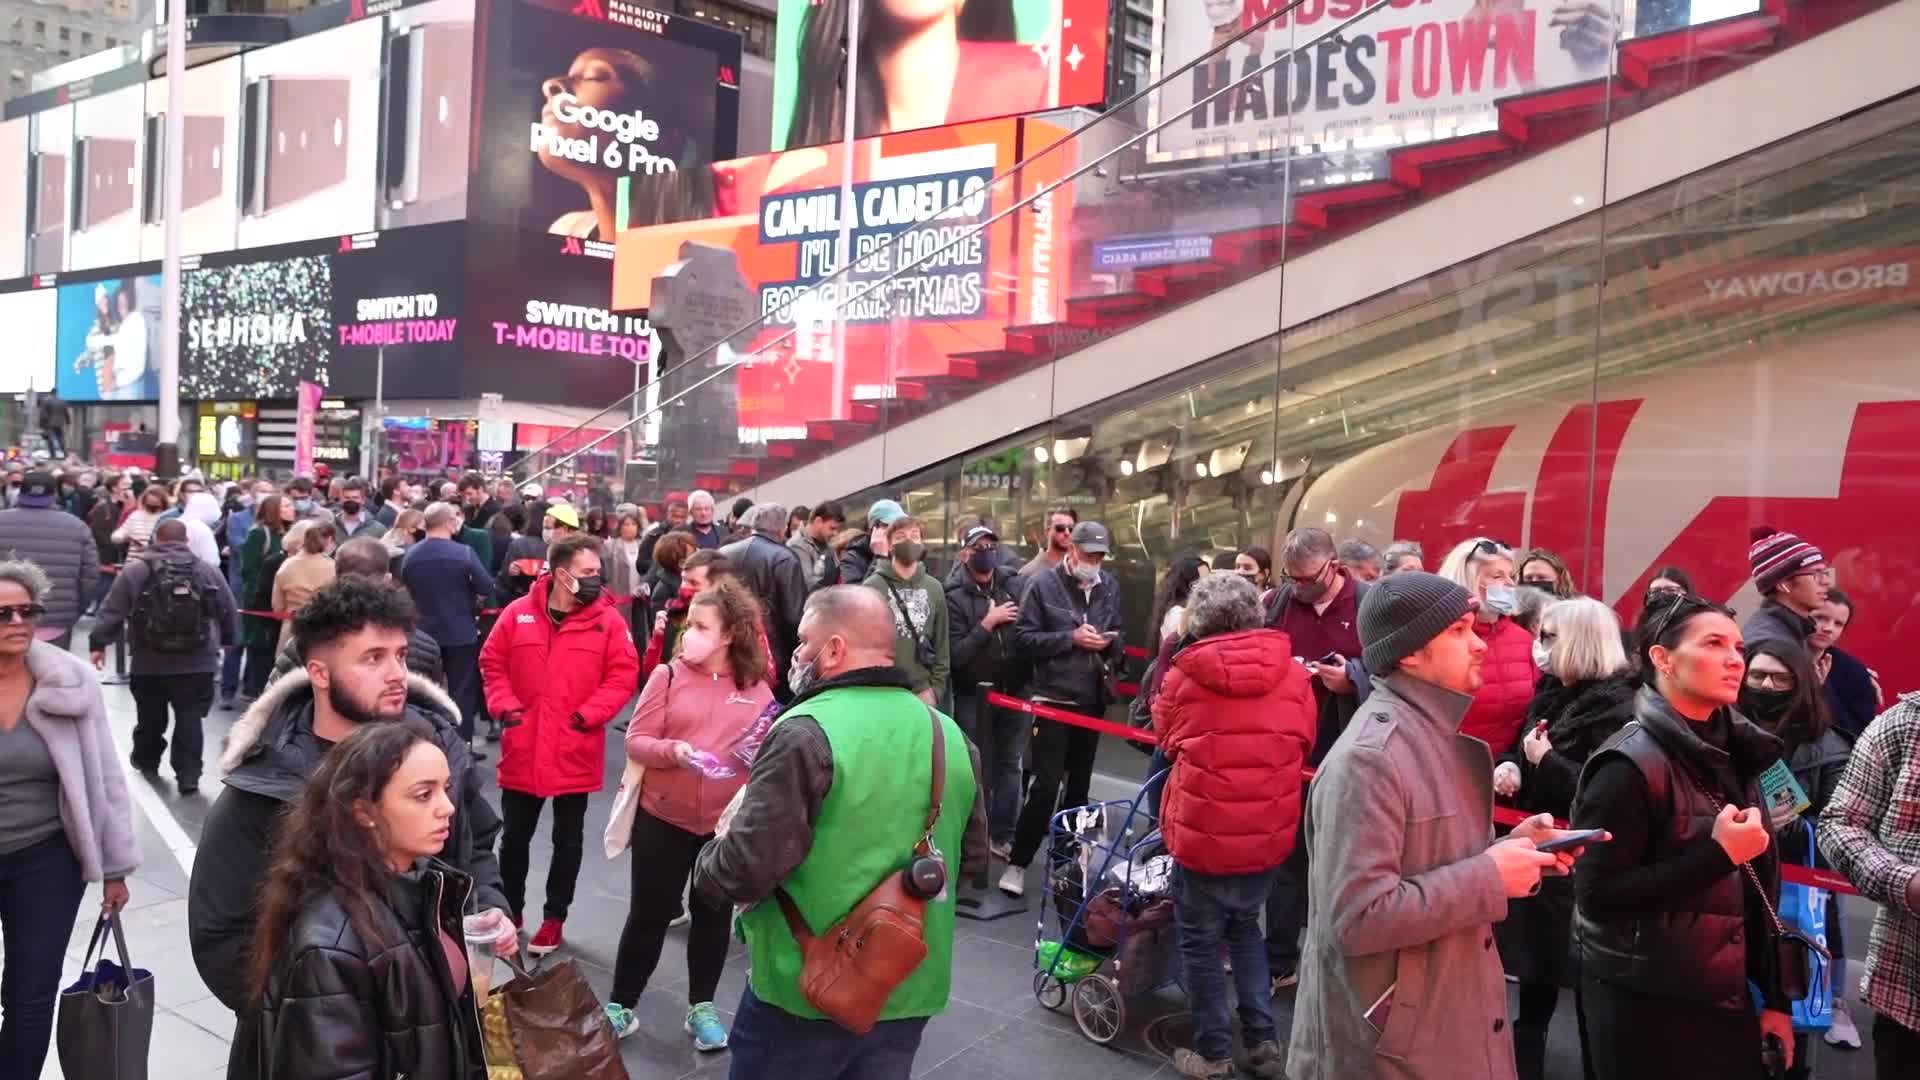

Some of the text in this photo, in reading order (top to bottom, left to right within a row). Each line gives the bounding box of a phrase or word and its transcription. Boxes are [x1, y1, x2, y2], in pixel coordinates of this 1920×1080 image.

[608, 0, 670, 25] MARRIOTT
[608, 11, 663, 34] MARQUIS
[1192, 10, 1537, 129] HADESTOWN
[552, 92, 660, 144] Google
[530, 122, 598, 164] Pixel
[602, 140, 623, 169] 6
[862, 175, 986, 227] CABELLO
[855, 232, 893, 274] BE
[897, 222, 983, 271] HOME
[356, 293, 438, 322] SWITCH TO
[525, 299, 619, 333] SWITCH
[187, 311, 307, 350] SEPHORA
[338, 318, 457, 346] T-MOBILE TODAY
[492, 321, 602, 355] T-MOBILE
[312, 446, 350, 460] EPHORA
